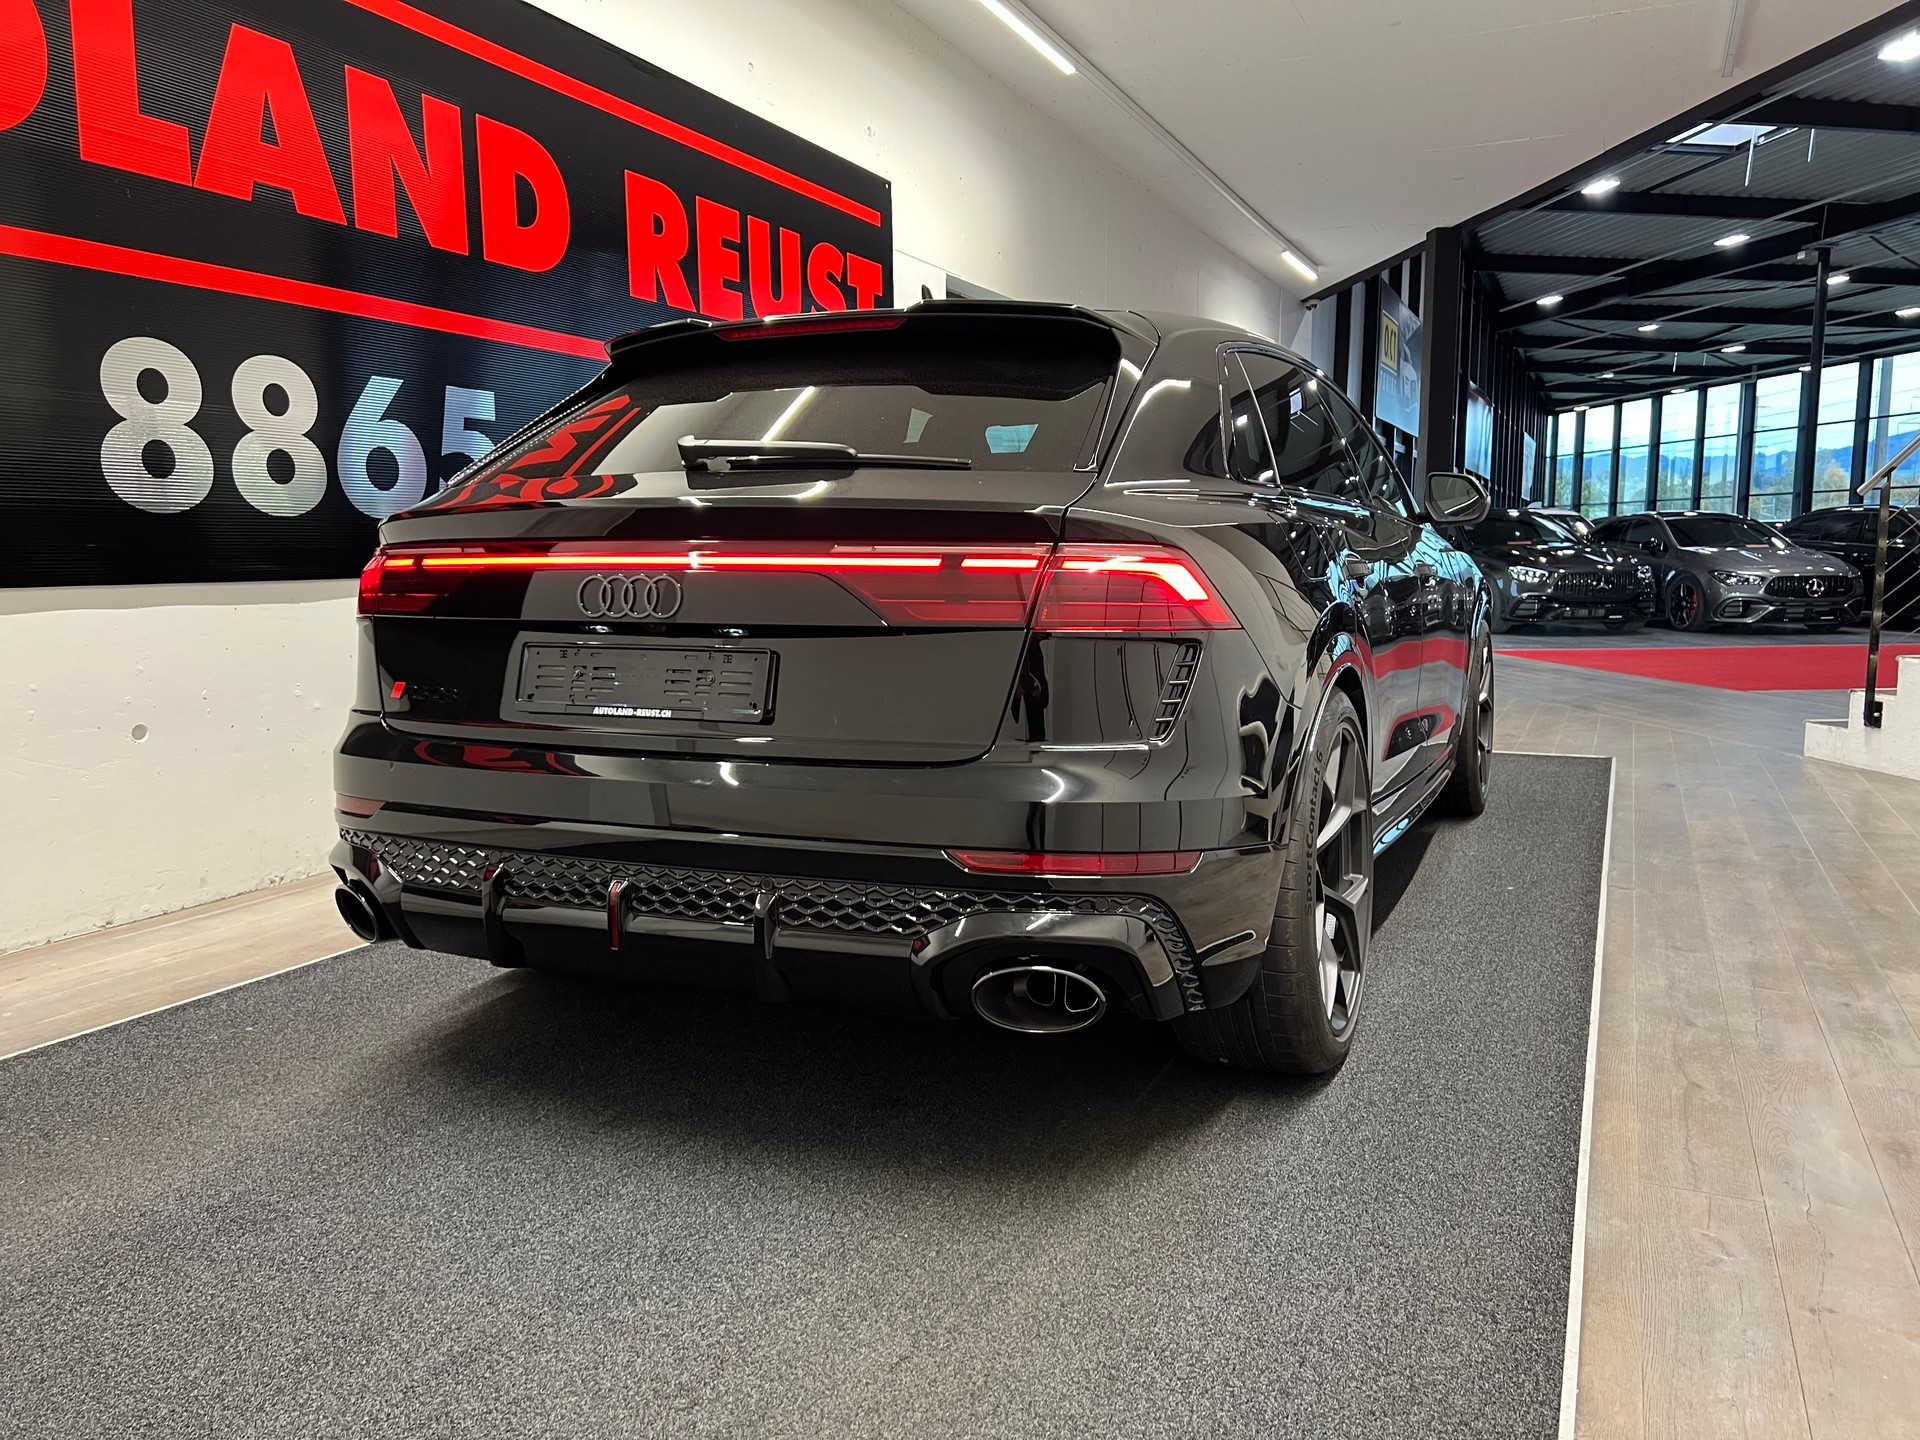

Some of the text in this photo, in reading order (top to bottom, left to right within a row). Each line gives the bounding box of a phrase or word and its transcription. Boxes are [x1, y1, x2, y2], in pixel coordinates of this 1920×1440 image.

[624, 168, 883, 322] REUST
[99, 336, 497, 519] 8865
[592, 706, 673, 718] AUTOLAND-REUST.CH
[1304, 749, 1324, 917] SportContact 6
